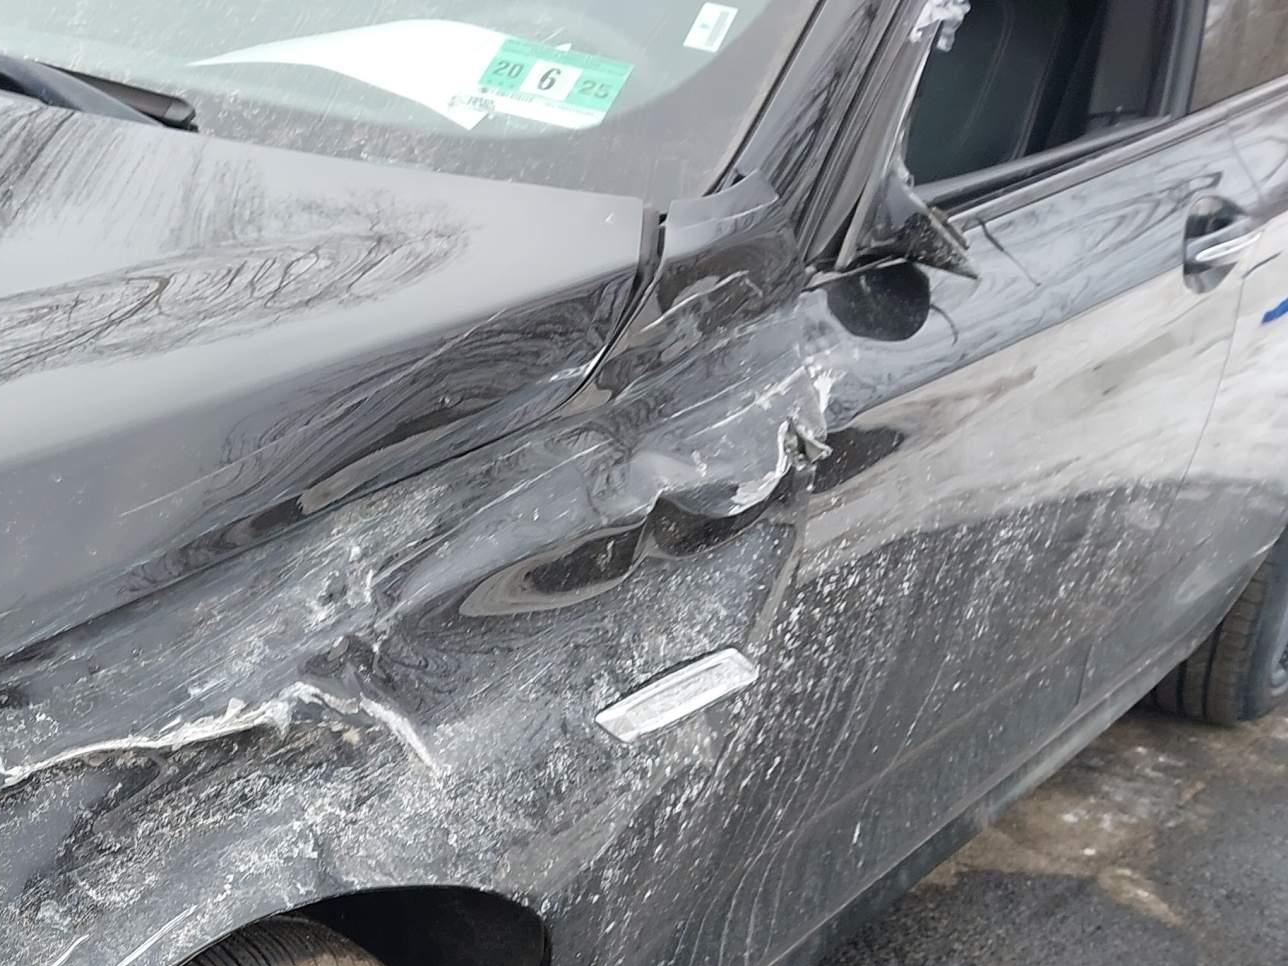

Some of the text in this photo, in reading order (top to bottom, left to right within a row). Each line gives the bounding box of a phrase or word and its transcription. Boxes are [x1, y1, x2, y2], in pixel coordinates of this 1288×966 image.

[492, 60, 611, 99] 20 6 25
